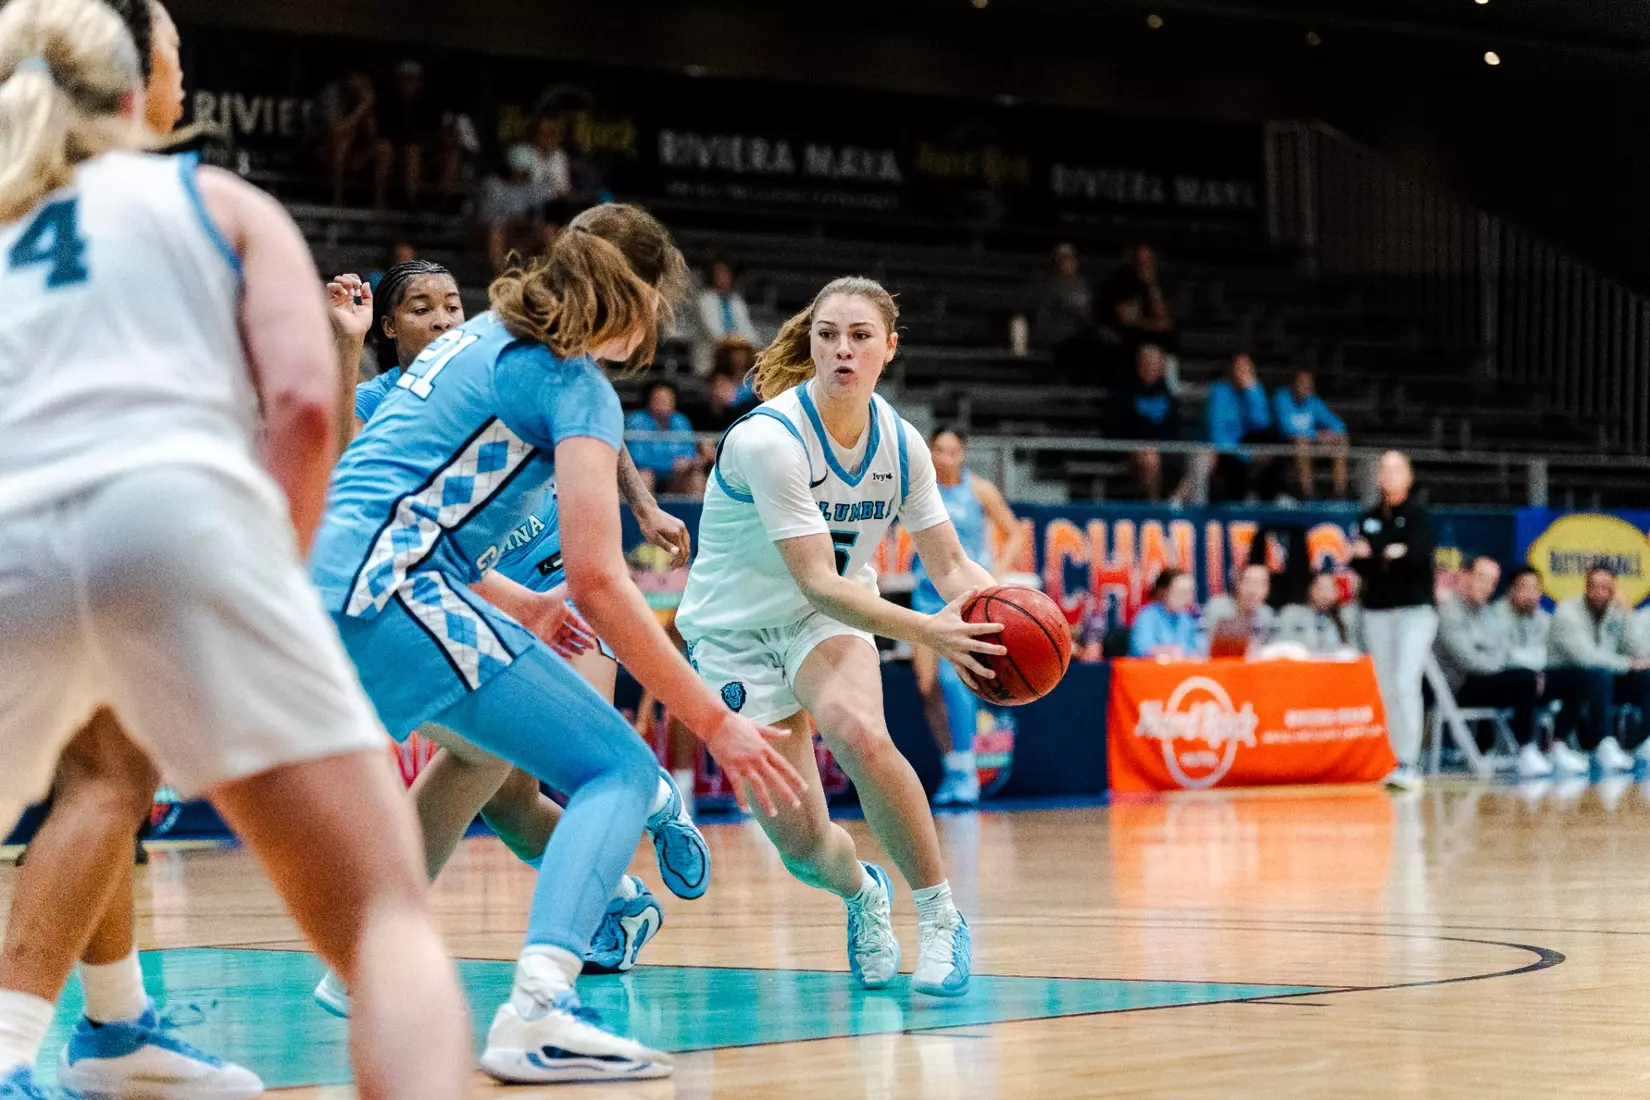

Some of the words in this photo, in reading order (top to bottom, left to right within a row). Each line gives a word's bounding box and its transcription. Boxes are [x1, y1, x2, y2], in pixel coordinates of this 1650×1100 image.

[657, 127, 796, 175] RIVIERA
[7, 197, 91, 288] 4
[872, 472, 886, 482] Ivy
